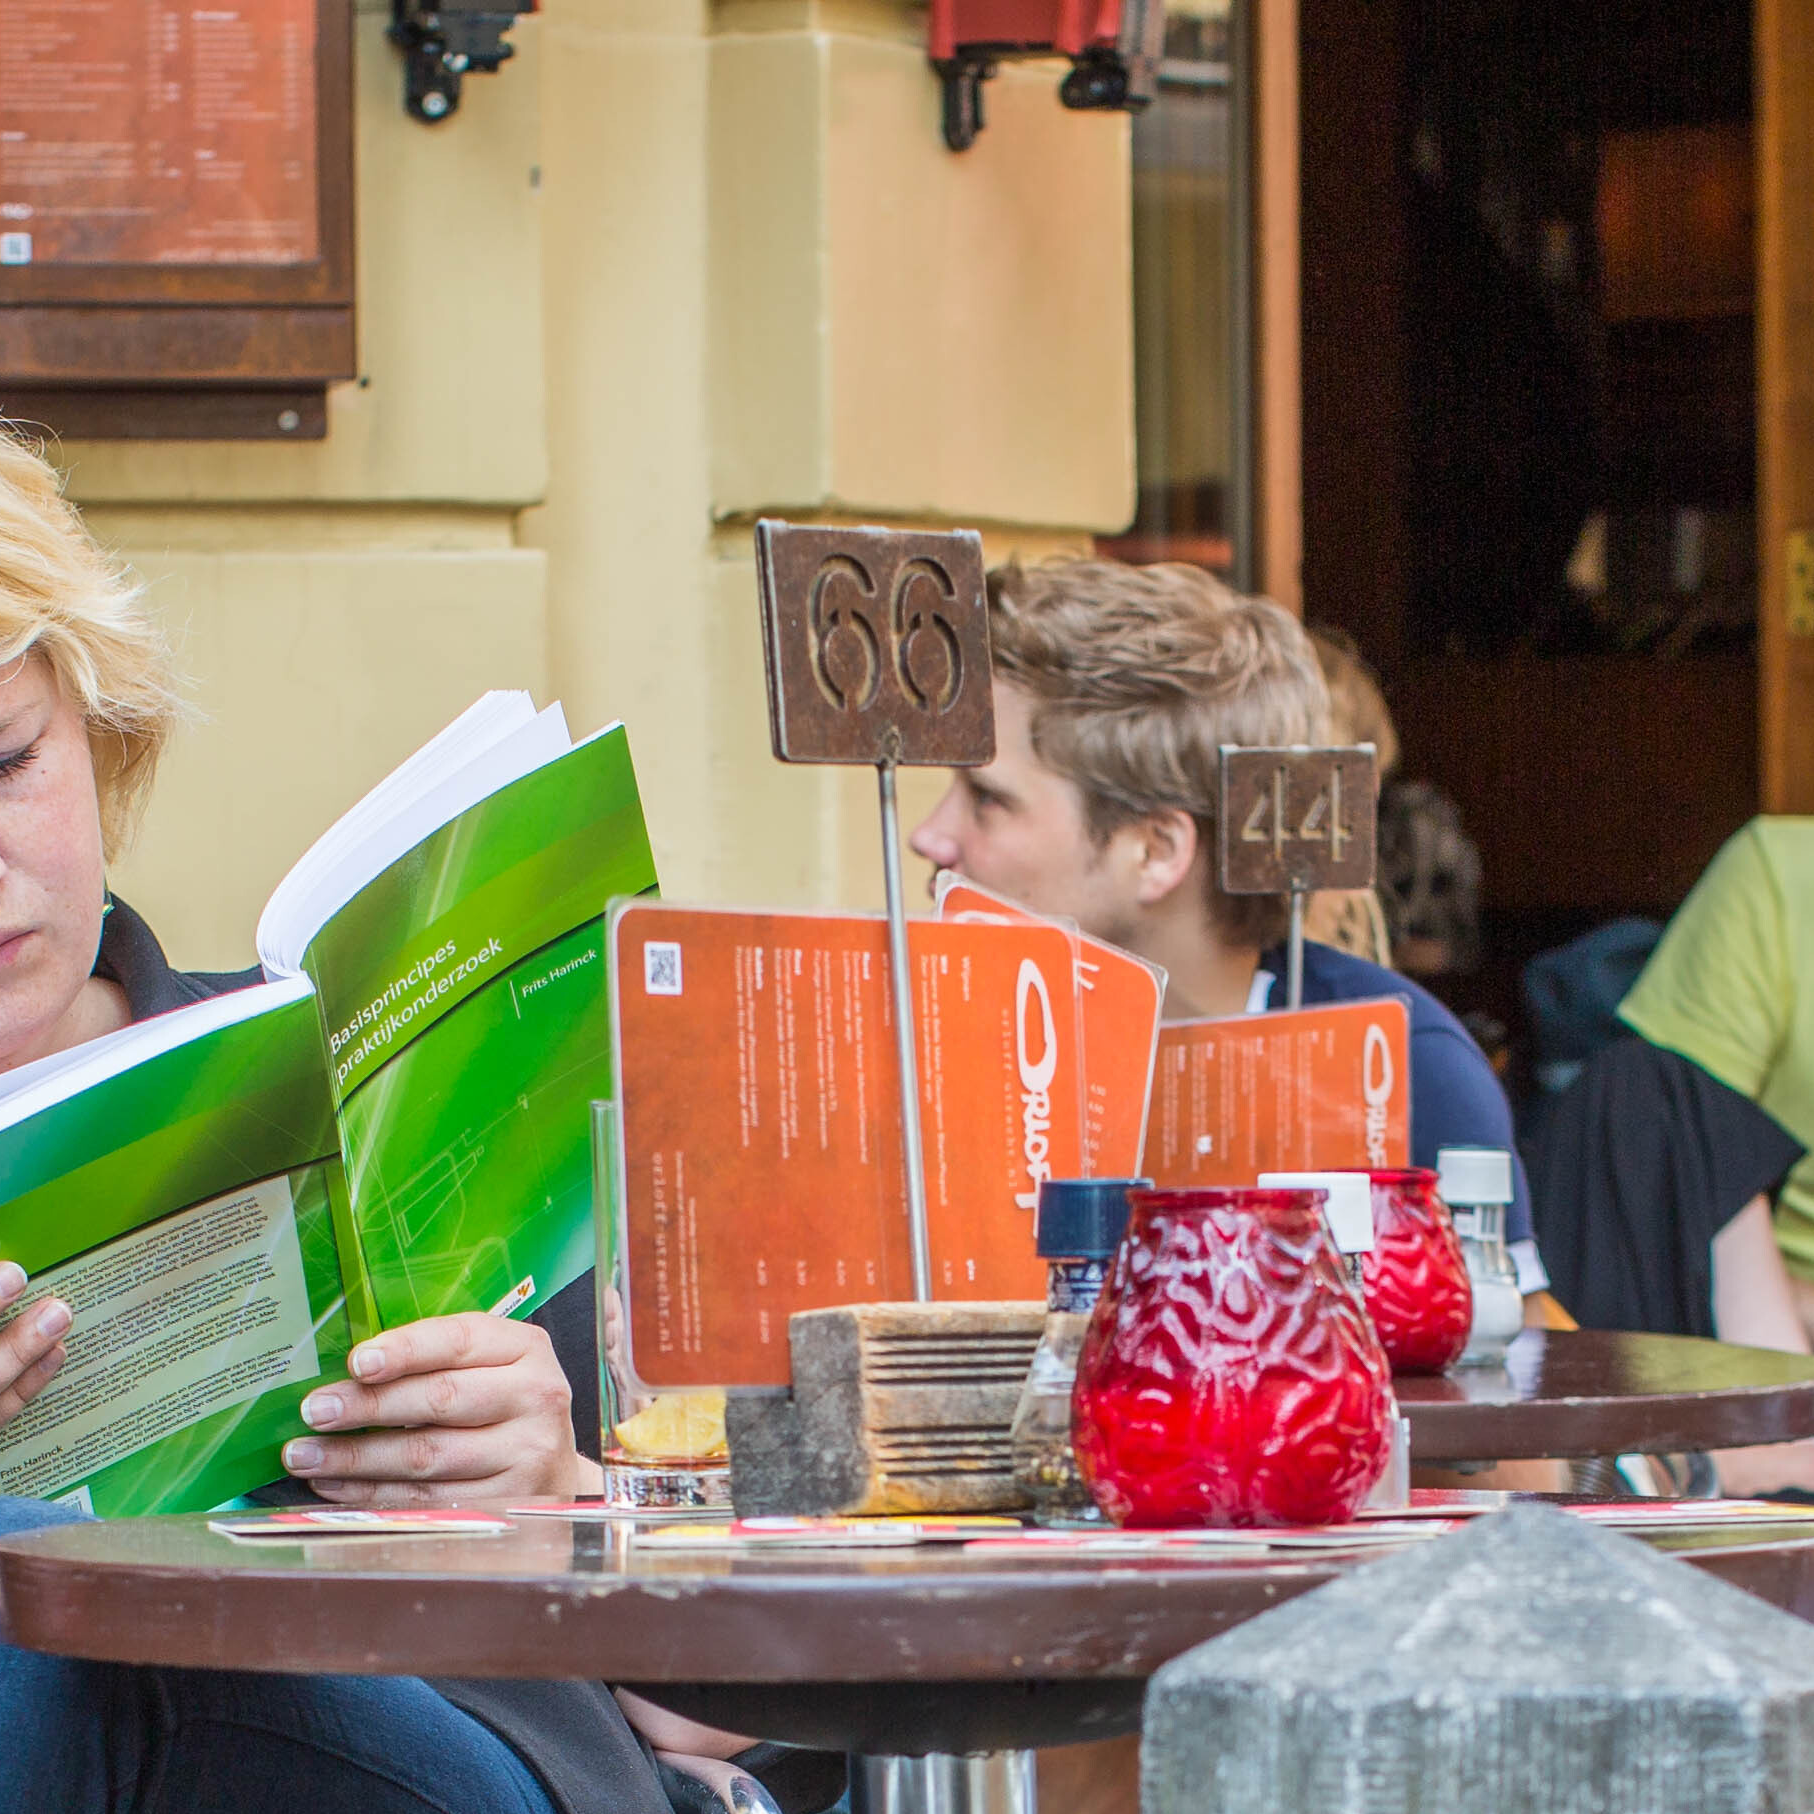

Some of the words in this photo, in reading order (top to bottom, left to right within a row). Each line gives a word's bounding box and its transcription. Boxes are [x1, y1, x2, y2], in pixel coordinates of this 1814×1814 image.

[807, 551, 963, 715] 66
[1240, 763, 1354, 863] 44
[329, 938, 457, 1056] Basisprincipes
[335, 936, 504, 1086] praktijkonderzoek
[521, 974, 549, 998] Frits
[548, 948, 598, 983] Harinck
